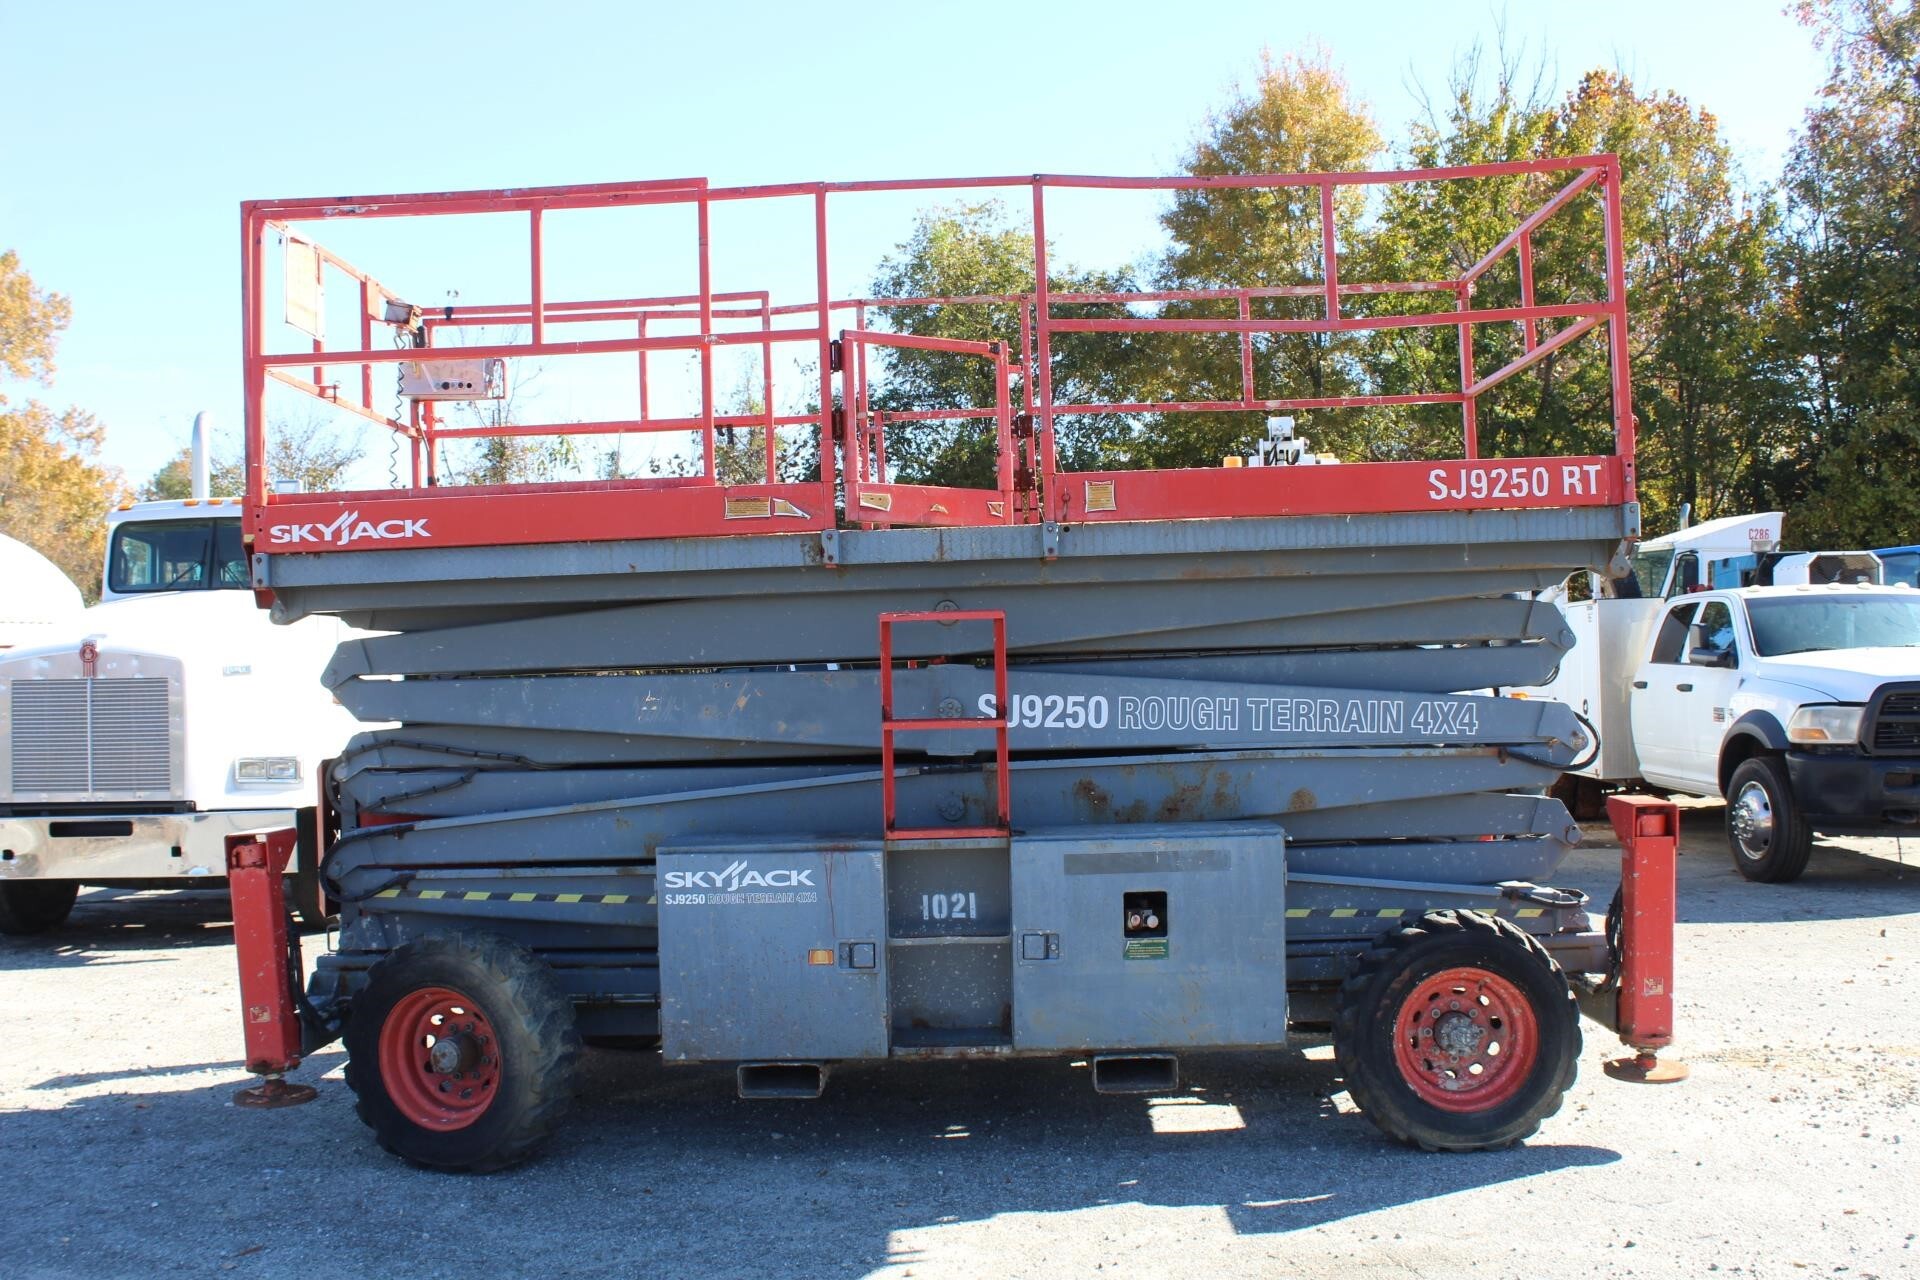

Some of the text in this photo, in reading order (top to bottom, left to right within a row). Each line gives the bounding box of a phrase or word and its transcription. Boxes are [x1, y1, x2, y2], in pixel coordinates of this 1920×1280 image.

[1428, 464, 1601, 500] SJ9250 RT
[269, 510, 432, 546] SKYJACK
[1748, 528, 1770, 540] C286
[977, 693, 1479, 735] SJ9250 ROUGH TERRAIN 4X4
[664, 859, 816, 892] SKYJACK
[665, 891, 817, 905] SJ9250 ROUGH TERRAIN 4X4
[922, 892, 977, 920] 1021
